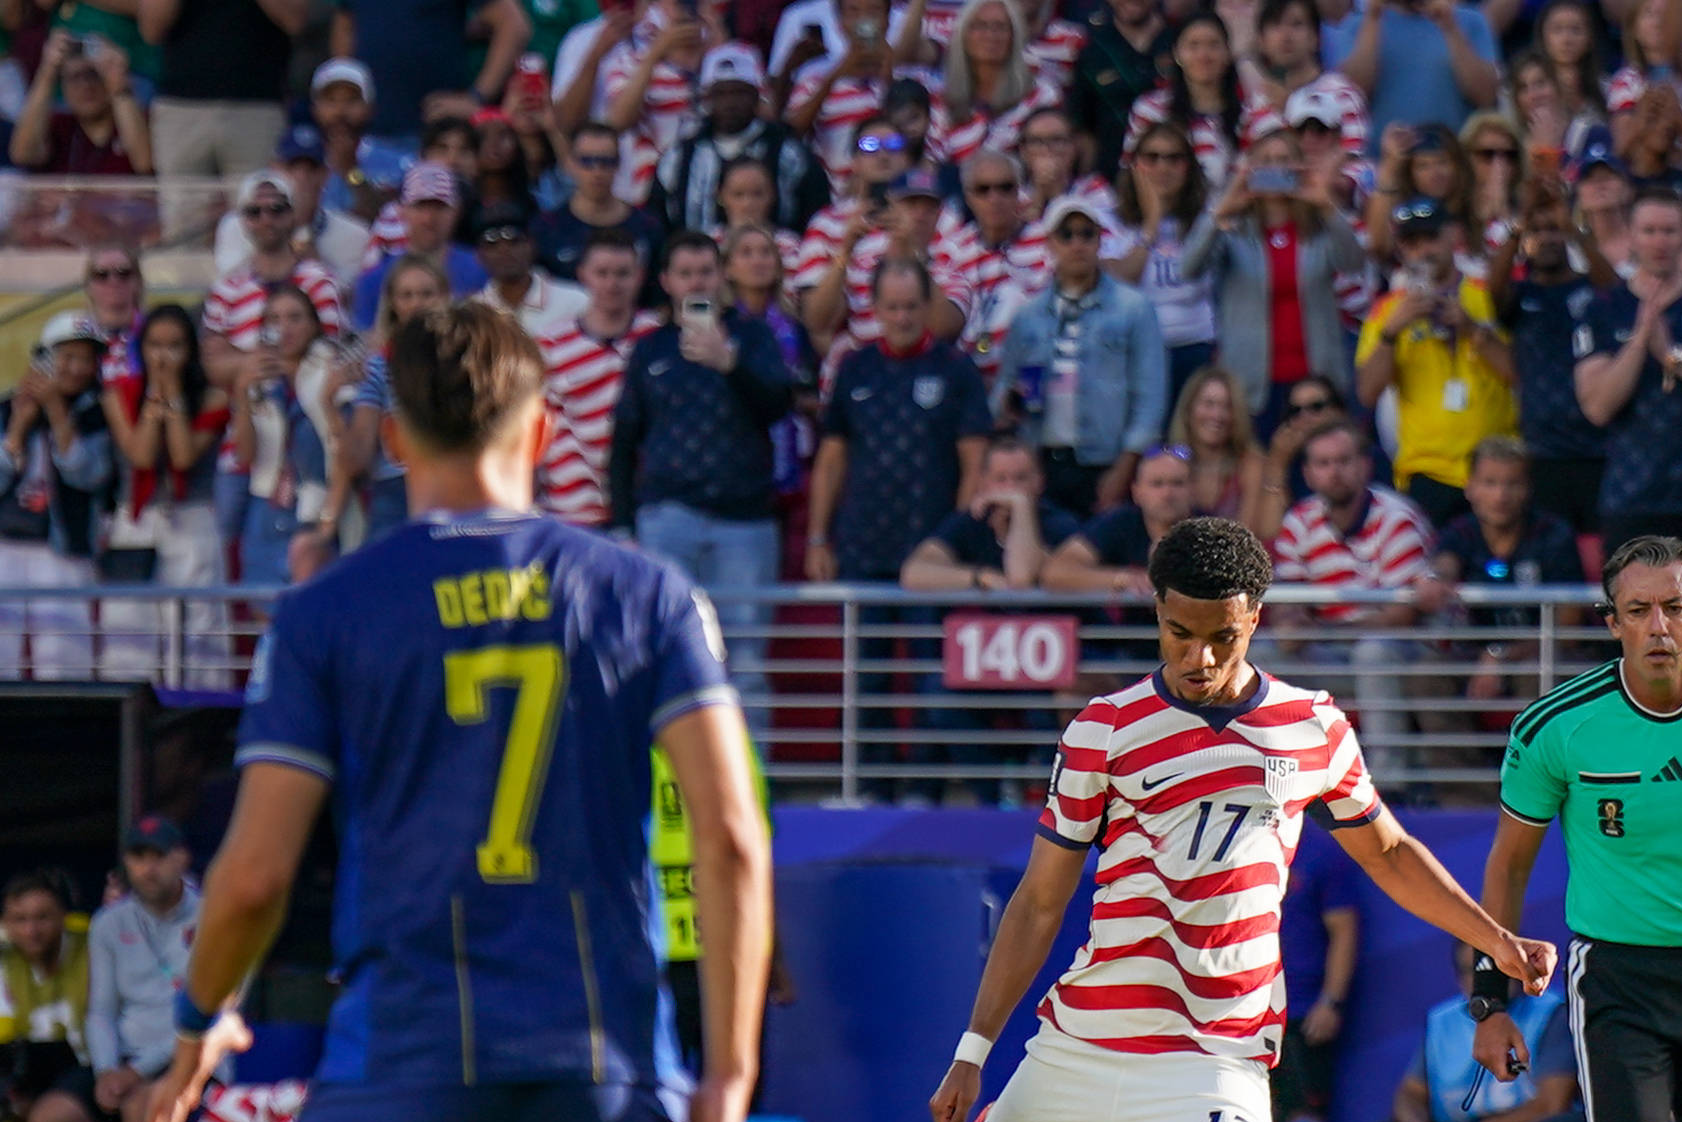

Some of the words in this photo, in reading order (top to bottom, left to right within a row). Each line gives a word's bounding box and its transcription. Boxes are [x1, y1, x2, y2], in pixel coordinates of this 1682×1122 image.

[956, 621, 1065, 682] 140
[443, 643, 570, 884] 7
[1267, 758, 1296, 777] USA
[1187, 801, 1252, 863] 17
